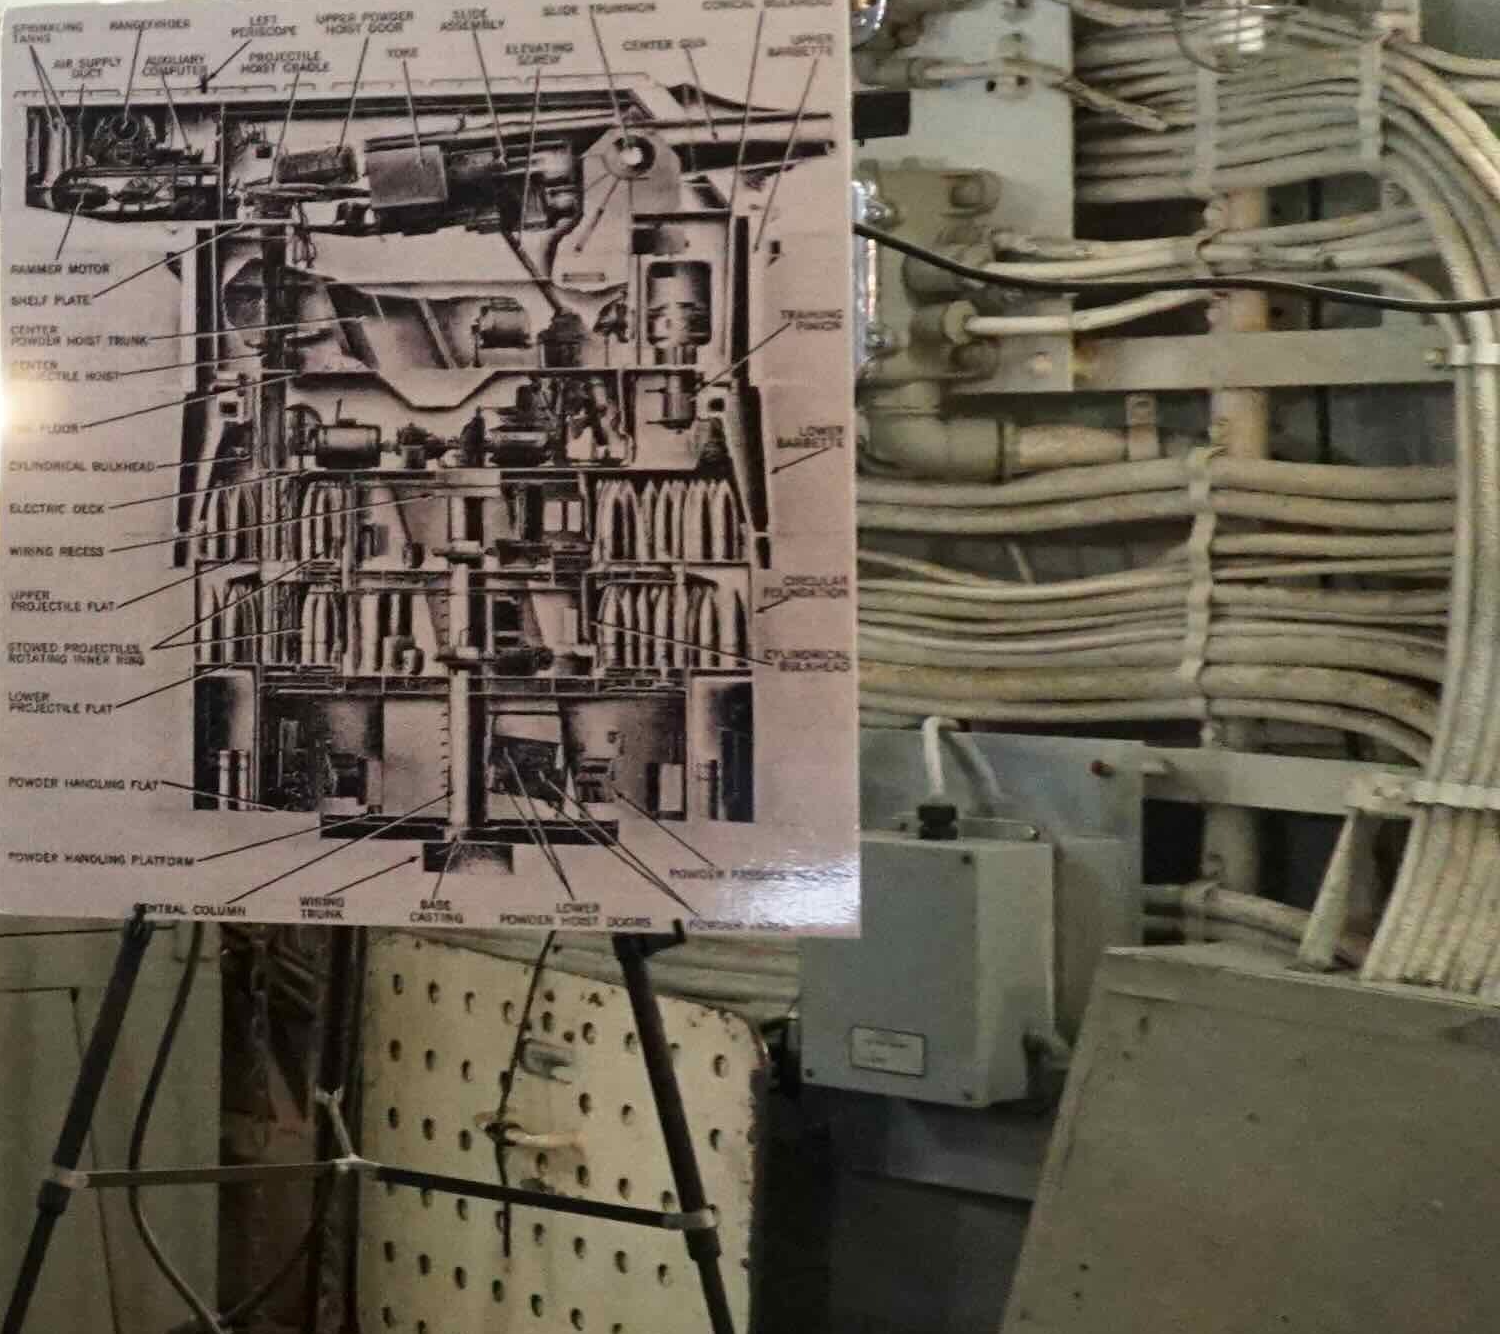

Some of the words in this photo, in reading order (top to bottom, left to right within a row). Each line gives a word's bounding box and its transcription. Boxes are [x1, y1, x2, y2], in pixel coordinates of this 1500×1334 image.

[452, 8, 487, 20] SLIDE
[542, 5, 578, 17] SLIDE
[250, 15, 277, 26] LEFT
[316, 13, 354, 24] UPPER
[361, 10, 414, 22] POWDER
[12, 22, 83, 34] SPRINKLING
[110, 19, 190, 30] RANGEFINDER
[326, 23, 361, 34] HOIST
[367, 22, 403, 33] DOOR
[439, 19, 505, 32] ASSEMBLY
[231, 26, 297, 38] PERISCOPE
[12, 34, 50, 44] TANKS
[790, 33, 834, 45] UPPER
[505, 43, 574, 55] ELEVATING
[622, 39, 673, 52] CENTER
[248, 51, 322, 62] PROJECTILE
[386, 47, 419, 59] YOKE
[53, 58, 73, 69] AIR
[79, 57, 121, 68] SUPPLY
[145, 55, 206, 66] AUXILIARY
[517, 54, 561, 66] SCREW
[71, 68, 103, 79] DUCT
[142, 66, 208, 77] COMPUTER
[240, 62, 276, 74] HOIST
[283, 62, 330, 73] CRADLE
[10, 264, 62, 275] RAMMER
[68, 264, 110, 274] MOTOR
[11, 295, 47, 306] SHELF
[54, 295, 91, 306] PLATE
[10, 325, 59, 334] CENTER
[11, 335, 61, 346] POWDER
[67, 336, 101, 346] HOIST
[108, 336, 149, 347] TRUNK
[85, 371, 119, 382] HOIST
[8, 462, 87, 472] CYLINDRICAL
[92, 461, 155, 472] BULKHEAD
[9, 503, 67, 515] ELECTRIC
[73, 504, 105, 515] DECK
[9, 546, 53, 557] WIRING
[59, 546, 105, 557] RECESS
[11, 590, 50, 600] UPPER
[11, 601, 81, 612] PROJECTILE
[87, 601, 115, 612] FLAT
[7, 642, 58, 653] STOWED
[8, 654, 67, 665] ROTATING
[74, 654, 110, 666] INNER
[116, 655, 145, 666] RING
[8, 691, 50, 702] LOWER
[8, 703, 81, 714] PROJECTILE
[85, 704, 112, 714] FLAT
[9, 777, 58, 788] POWDER
[65, 779, 124, 790] HANDLING
[132, 780, 159, 791] FLAT
[8, 852, 58, 863] POWDER
[64, 853, 125, 865] HANDLING
[132, 855, 193, 866] PLATFORM
[300, 897, 344, 907] WIRING
[420, 899, 450, 910] BASE
[193, 905, 246, 916] COLUMN
[556, 903, 599, 913] LOWER
[300, 908, 343, 920] TRUNK
[409, 911, 464, 923] CASTING
[500, 915, 554, 926] POWDER
[561, 916, 597, 927] HOIST
[607, 917, 652, 927] DOORS
